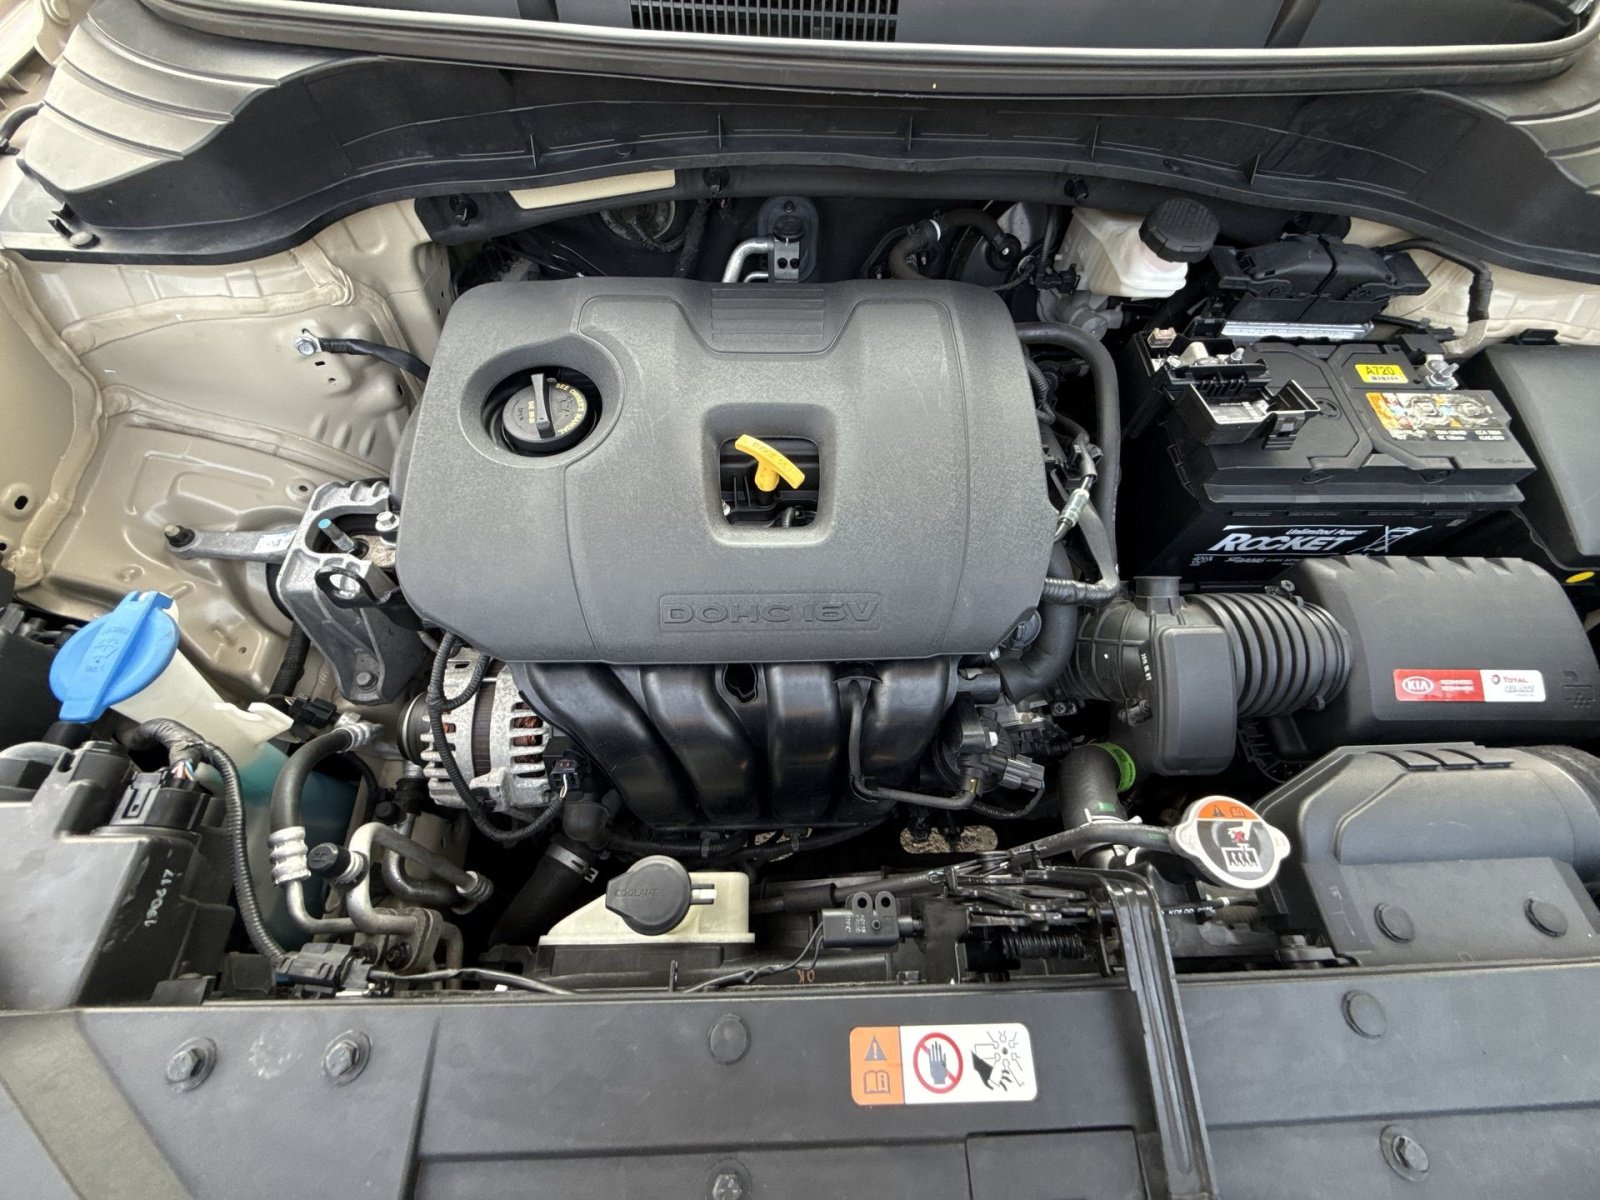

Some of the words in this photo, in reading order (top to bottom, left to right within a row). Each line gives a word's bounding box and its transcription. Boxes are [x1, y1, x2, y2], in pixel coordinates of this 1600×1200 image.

[1366, 366, 1395, 376] A720
[555, 383, 570, 391] SEE
[557, 413, 584, 434] MANUAL
[1207, 533, 1356, 552] ROCKET
[663, 603, 794, 624] DOHC
[803, 601, 878, 623] 16V
[615, 888, 660, 898] COOLANT
